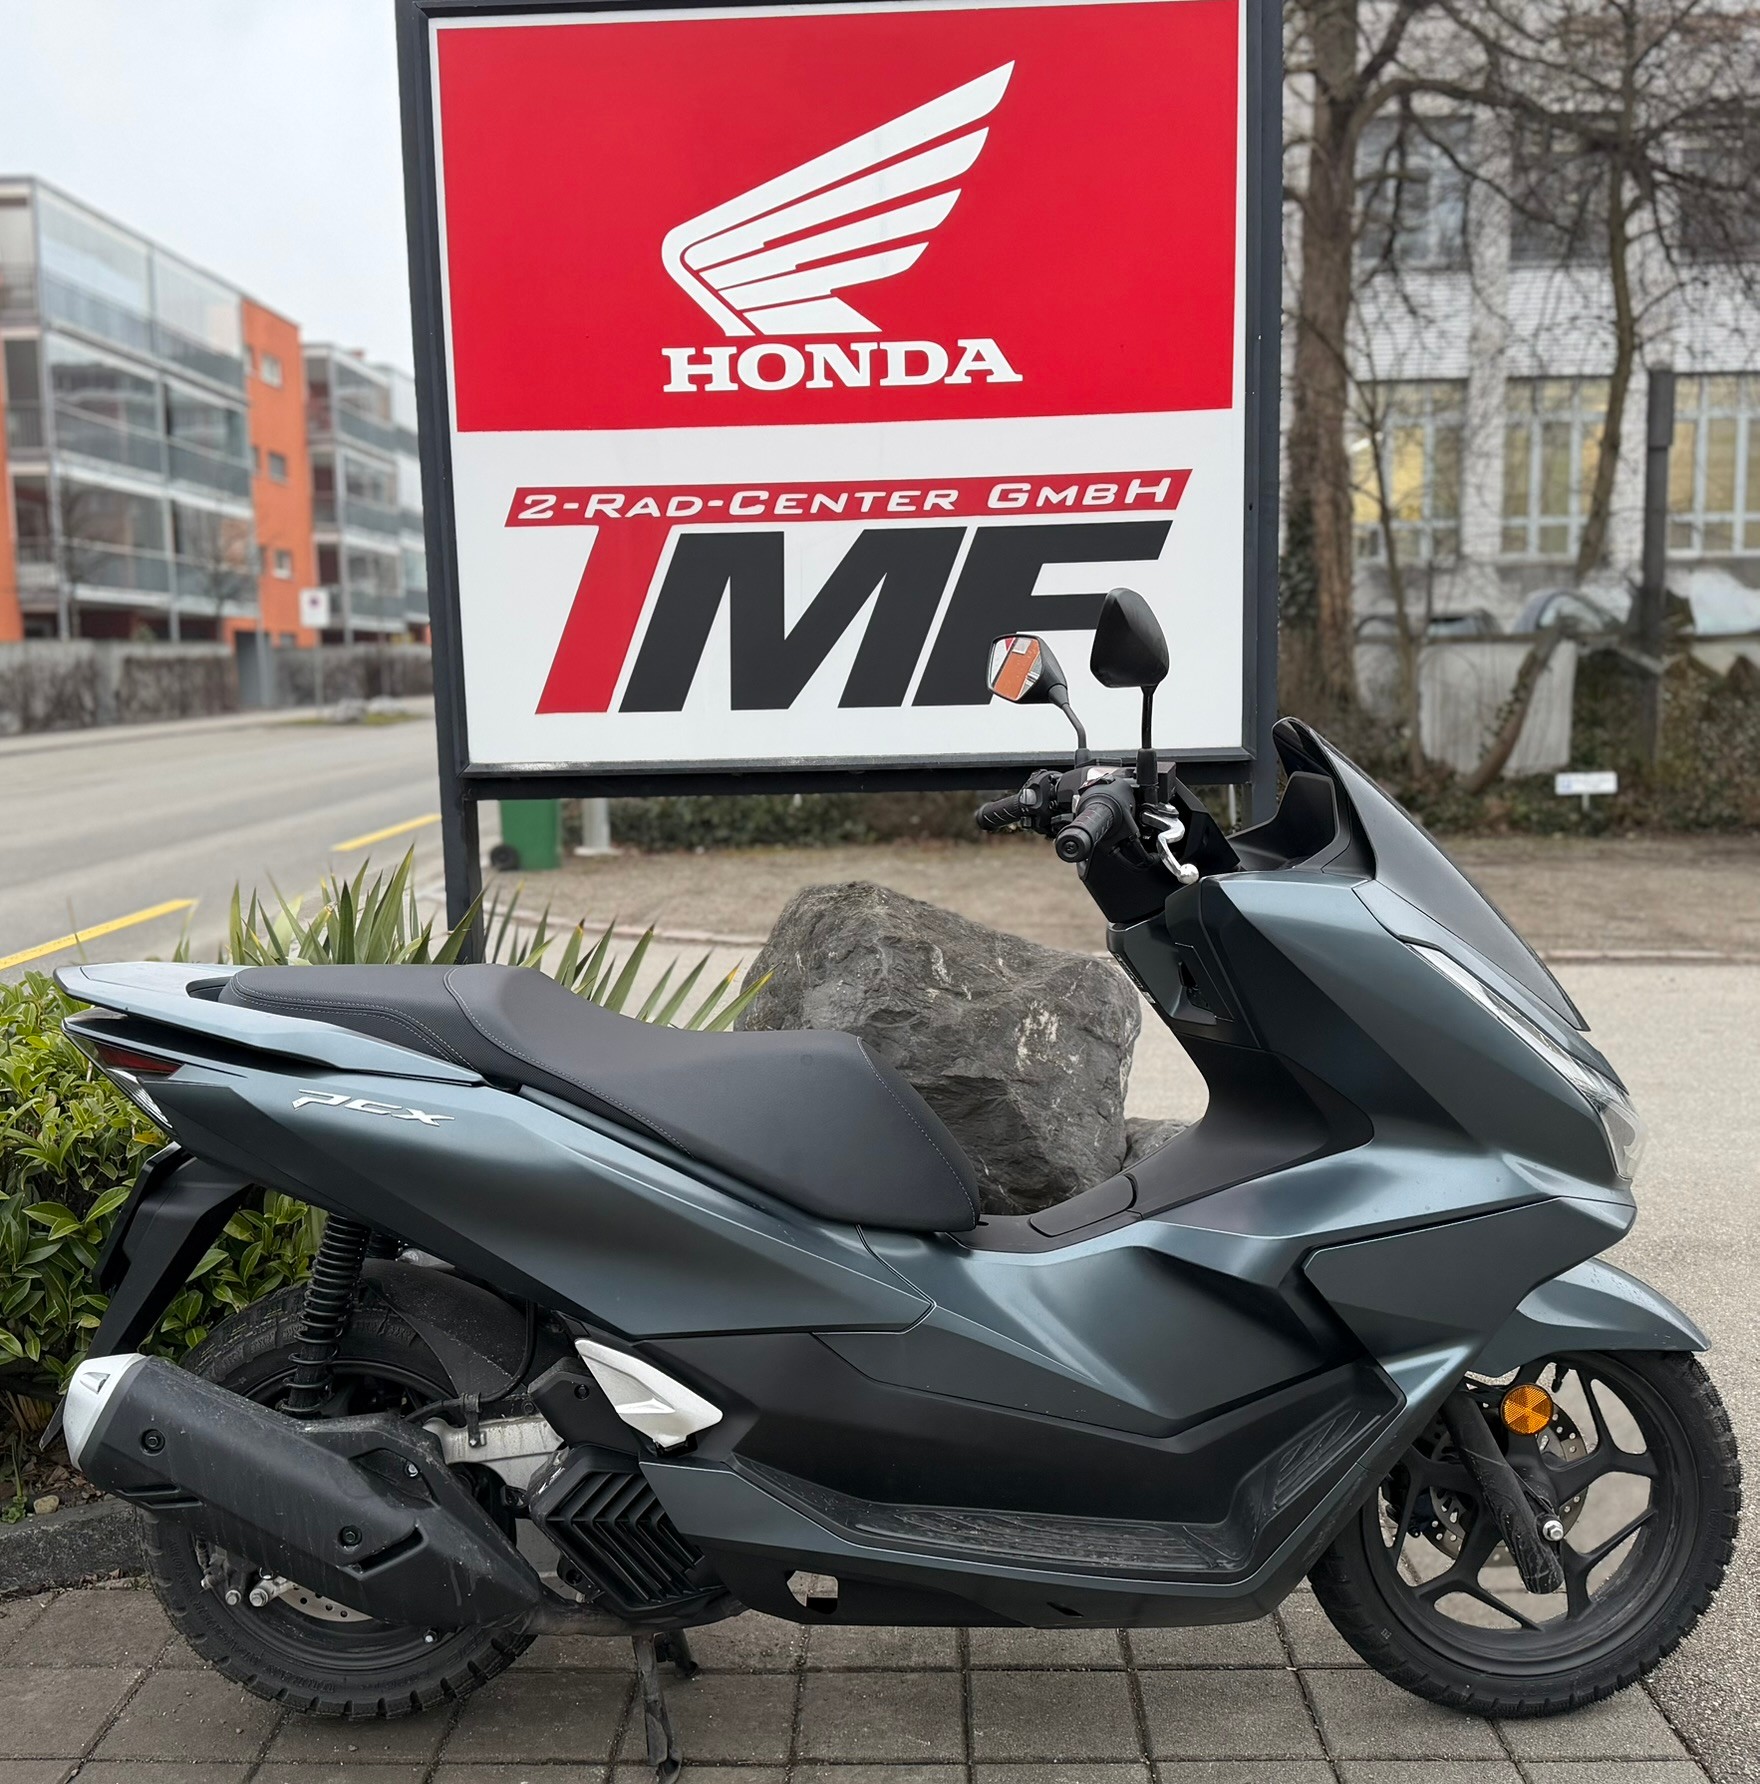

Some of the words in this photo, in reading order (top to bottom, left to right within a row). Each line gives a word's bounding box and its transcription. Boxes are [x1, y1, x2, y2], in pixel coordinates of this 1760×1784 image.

[661, 338, 1023, 392] HONDA
[535, 518, 1172, 715] TMF
[292, 1089, 455, 1127] PCX
